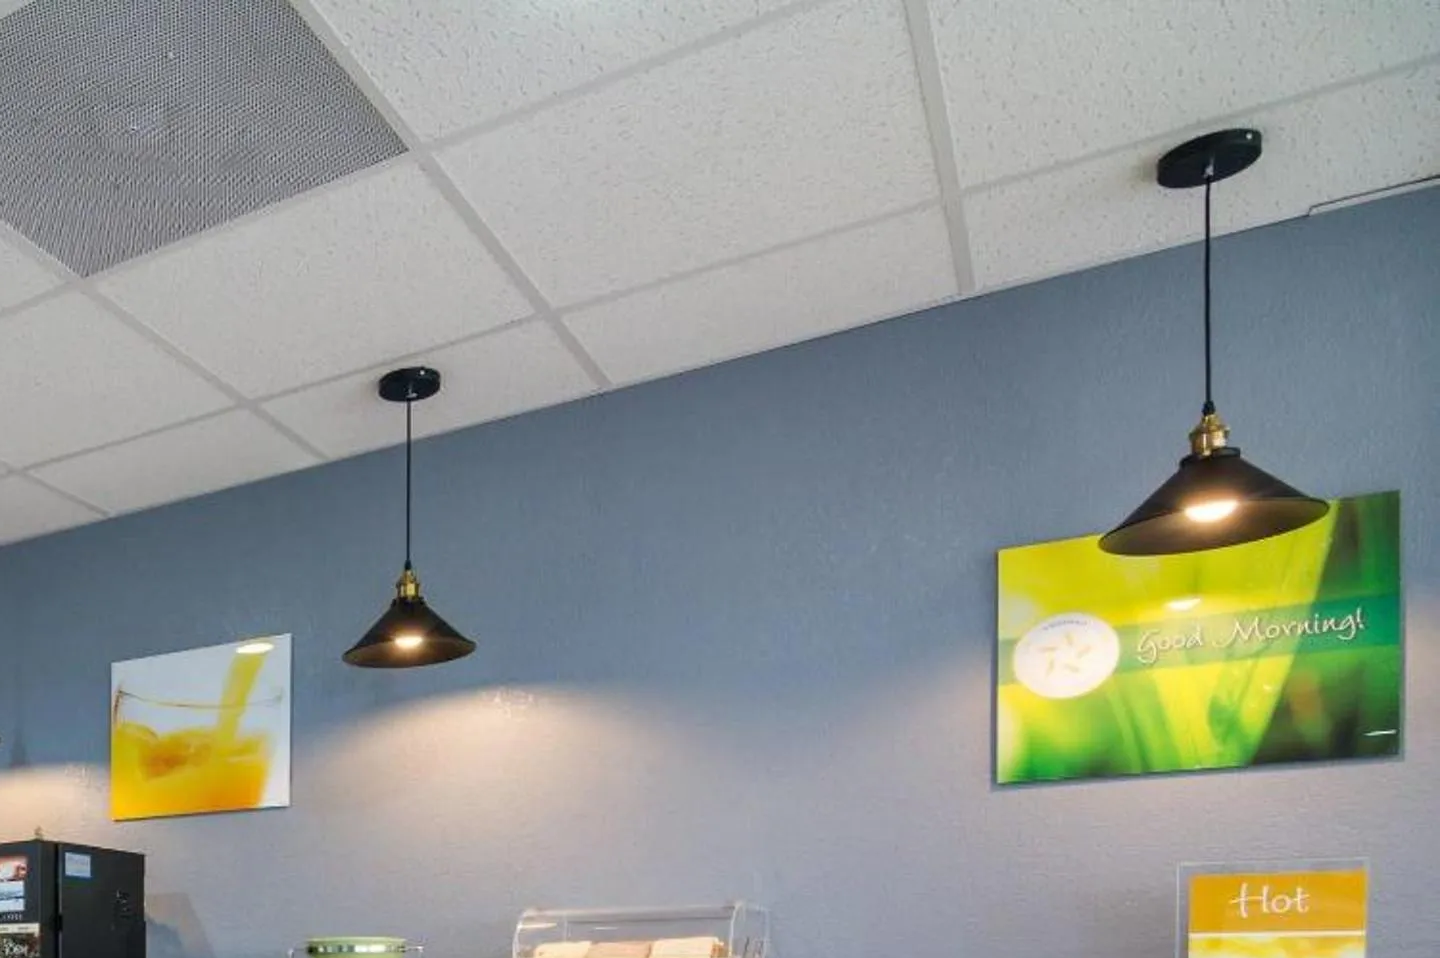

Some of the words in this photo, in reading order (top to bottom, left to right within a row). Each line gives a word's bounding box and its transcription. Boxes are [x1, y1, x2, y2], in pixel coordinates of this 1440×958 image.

[1136, 625, 1203, 664] Good
[1212, 606, 1364, 649] Morning!
[1230, 882, 1311, 918] Hot
